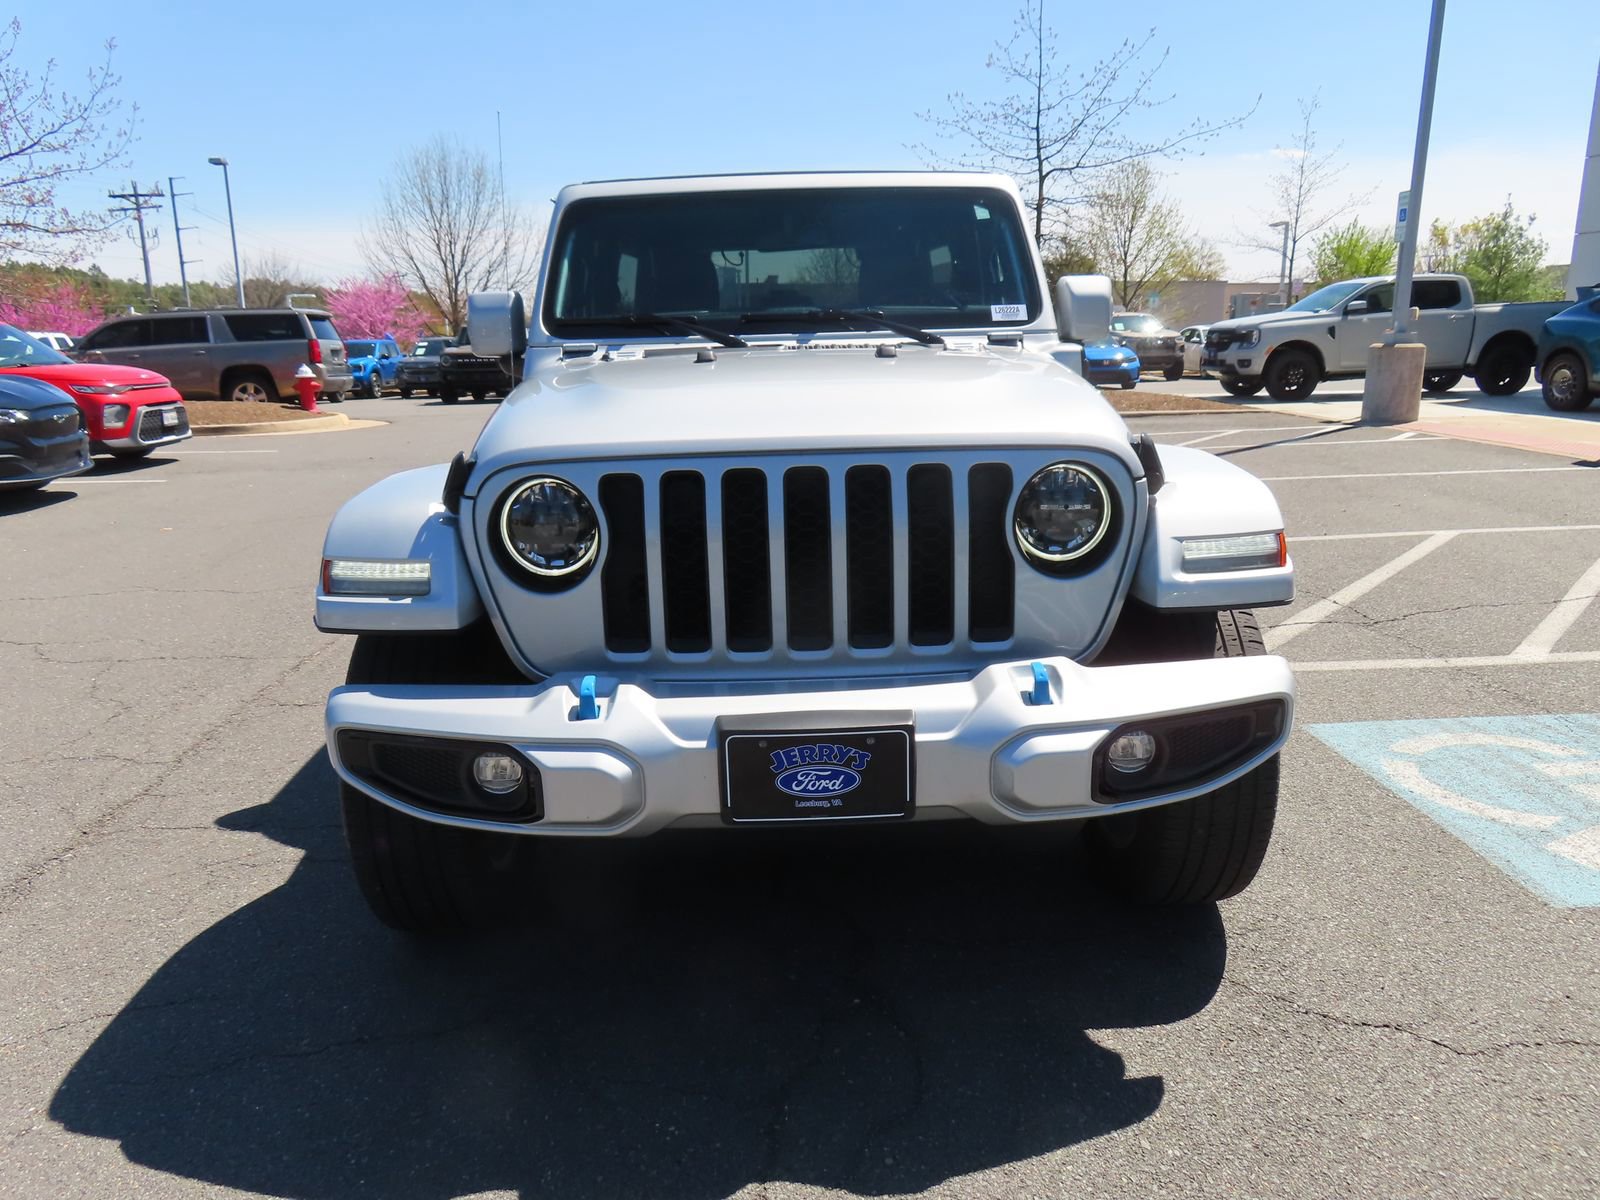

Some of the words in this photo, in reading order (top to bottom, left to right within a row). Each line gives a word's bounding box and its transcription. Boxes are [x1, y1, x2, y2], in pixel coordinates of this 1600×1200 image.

[770, 744, 872, 773] JERRY'S
[792, 770, 845, 791] Ford
[795, 799, 831, 808] Leesburg,
[831, 799, 842, 807] VA
